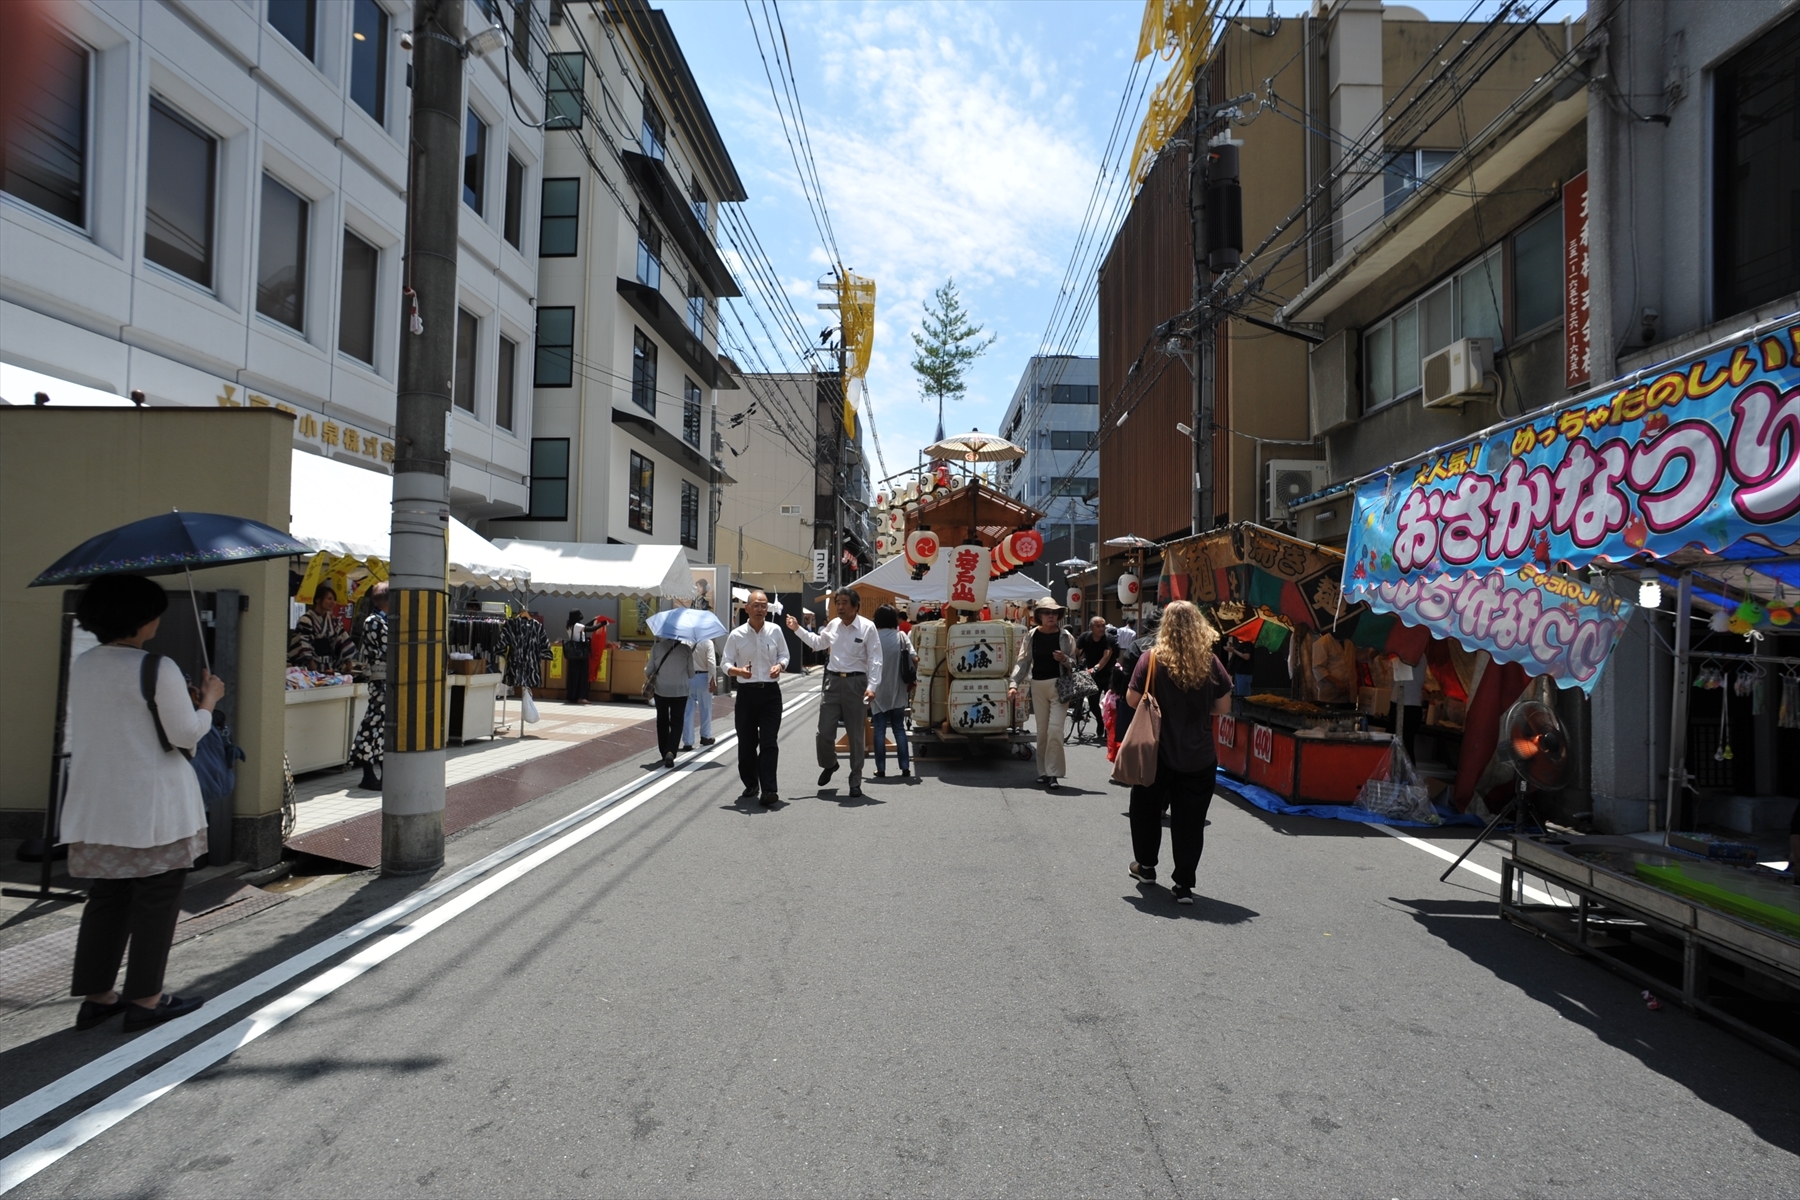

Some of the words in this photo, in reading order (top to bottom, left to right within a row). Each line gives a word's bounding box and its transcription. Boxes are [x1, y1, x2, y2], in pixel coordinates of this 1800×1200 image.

[1393, 380, 1800, 573] おさかなつり
[816, 552, 825, 579] コタニ
